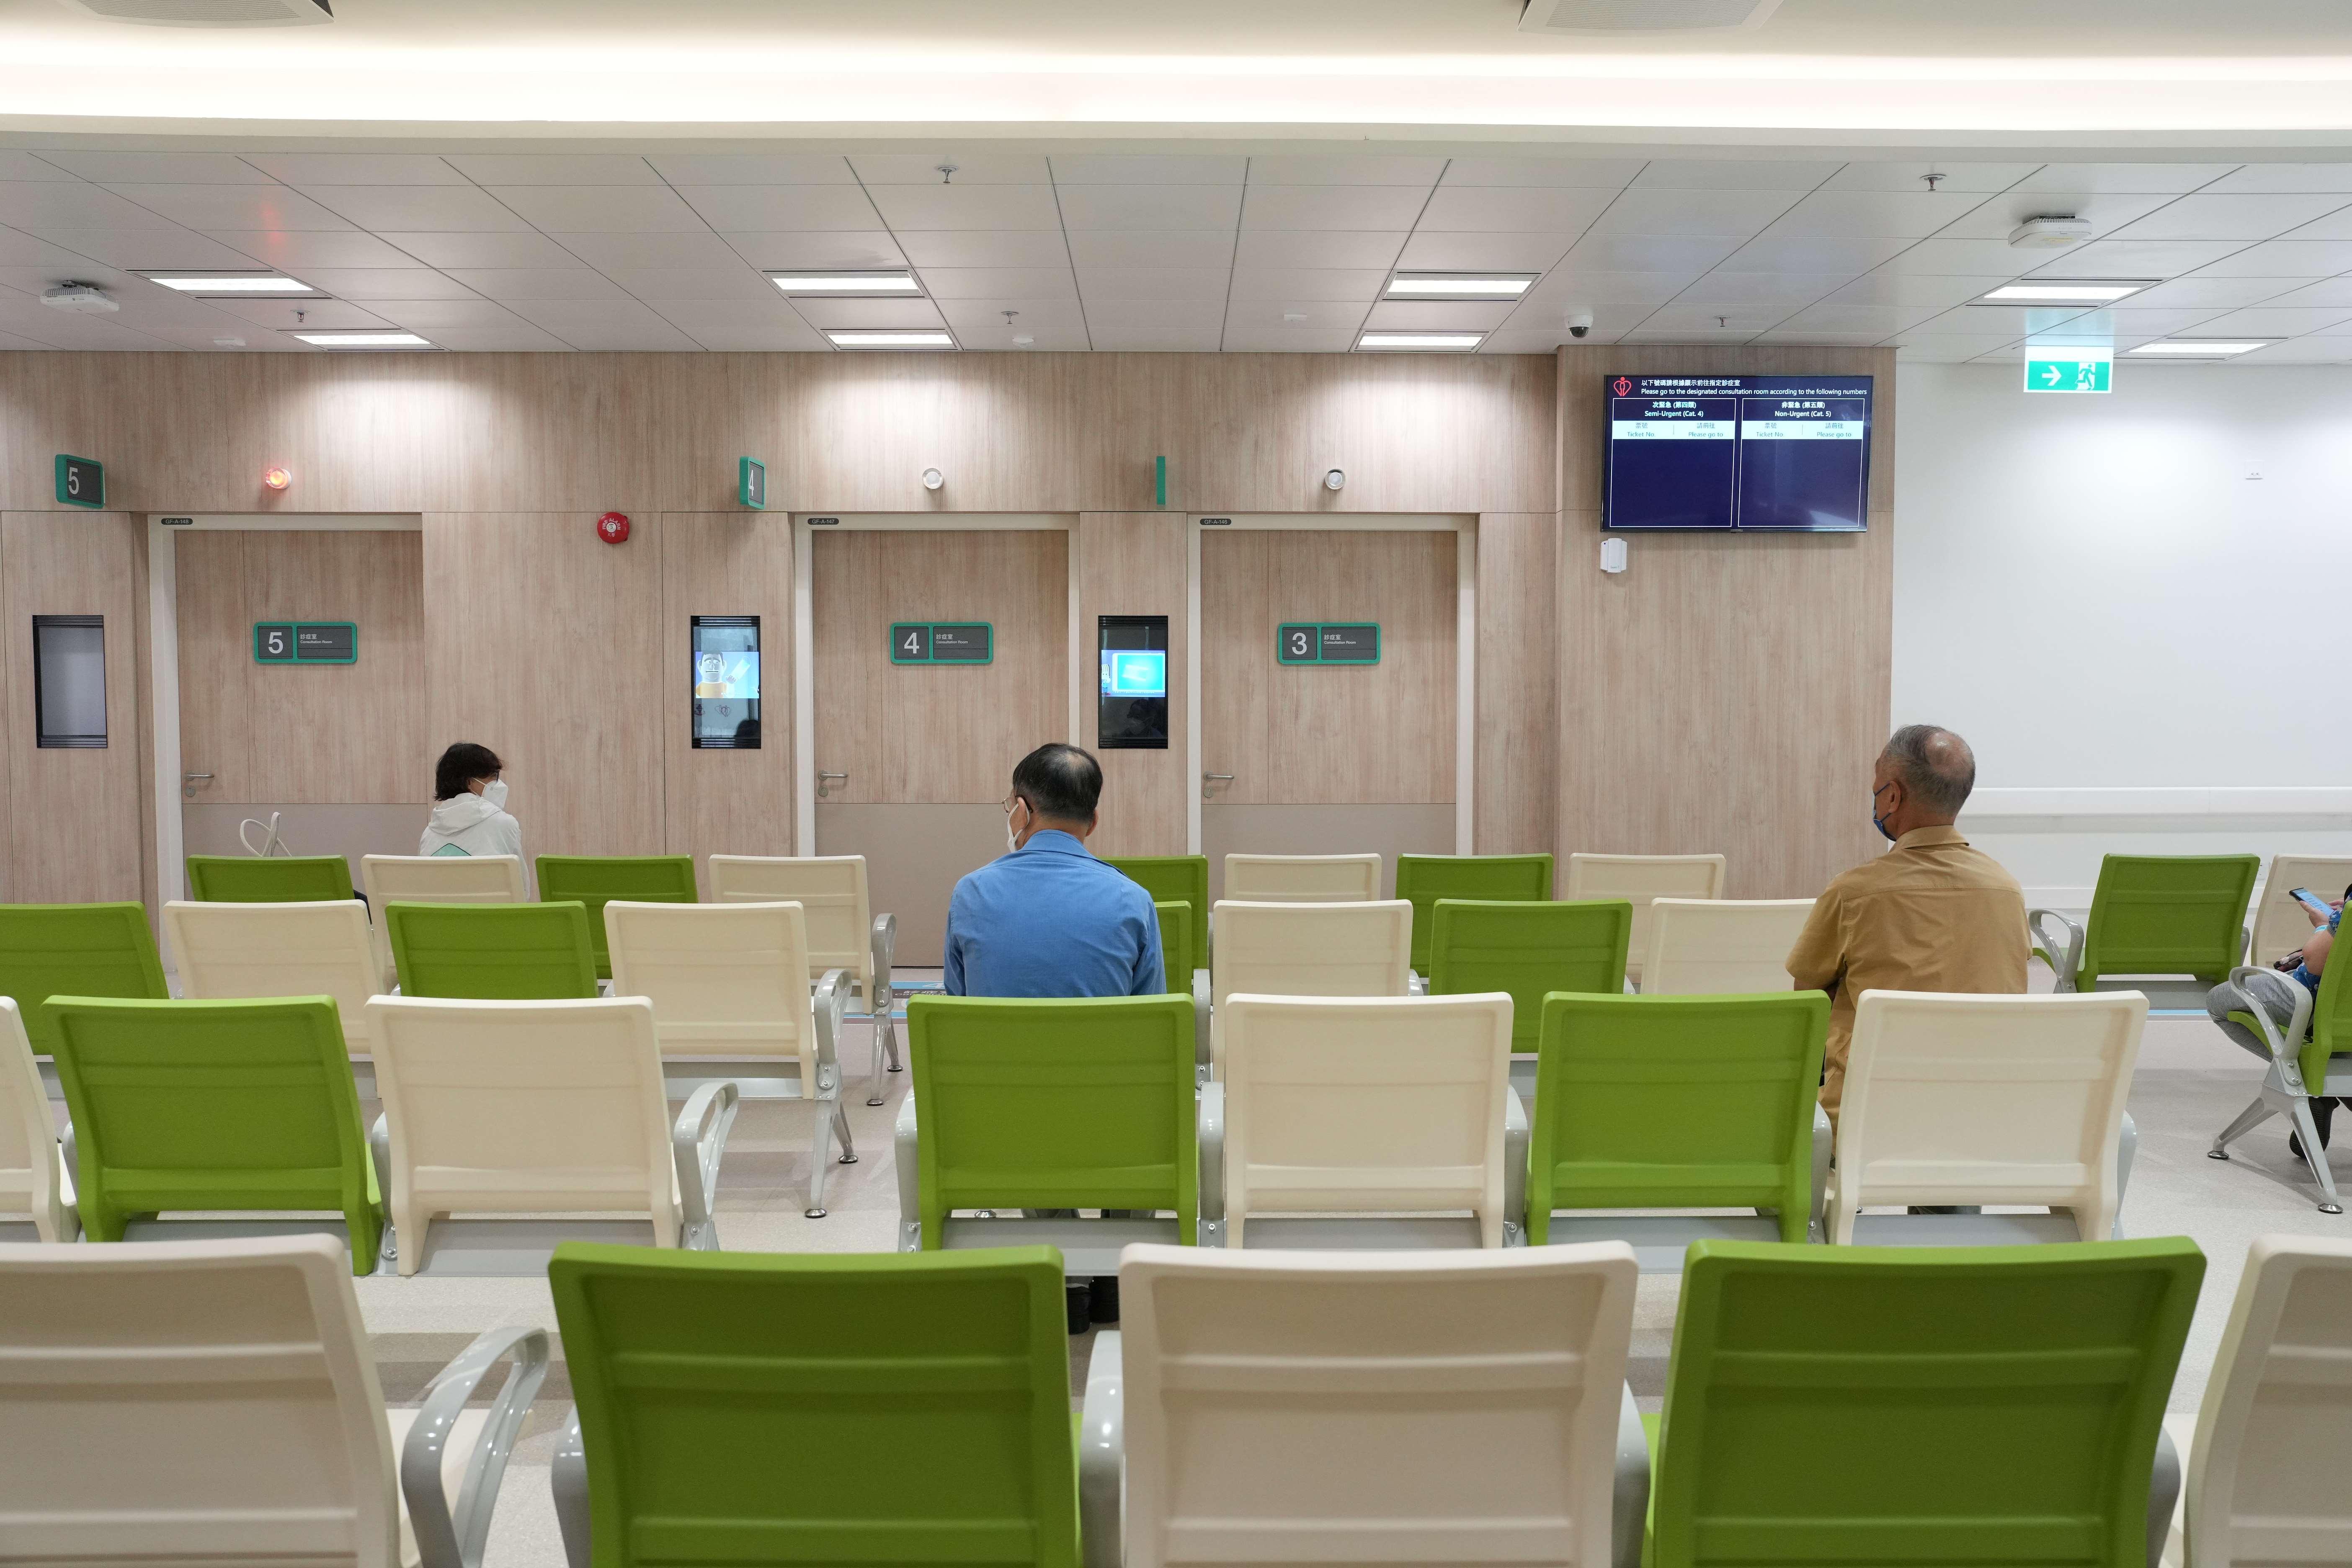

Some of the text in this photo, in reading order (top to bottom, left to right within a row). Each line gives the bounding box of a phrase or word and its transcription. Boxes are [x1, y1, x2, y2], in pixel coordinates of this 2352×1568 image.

[69, 467, 79, 495] 5
[749, 469, 754, 496] 4
[609, 518, 621, 530] ALARM
[268, 632, 283, 654] 5
[904, 632, 919, 654] 4
[1292, 633, 1307, 655] 3
